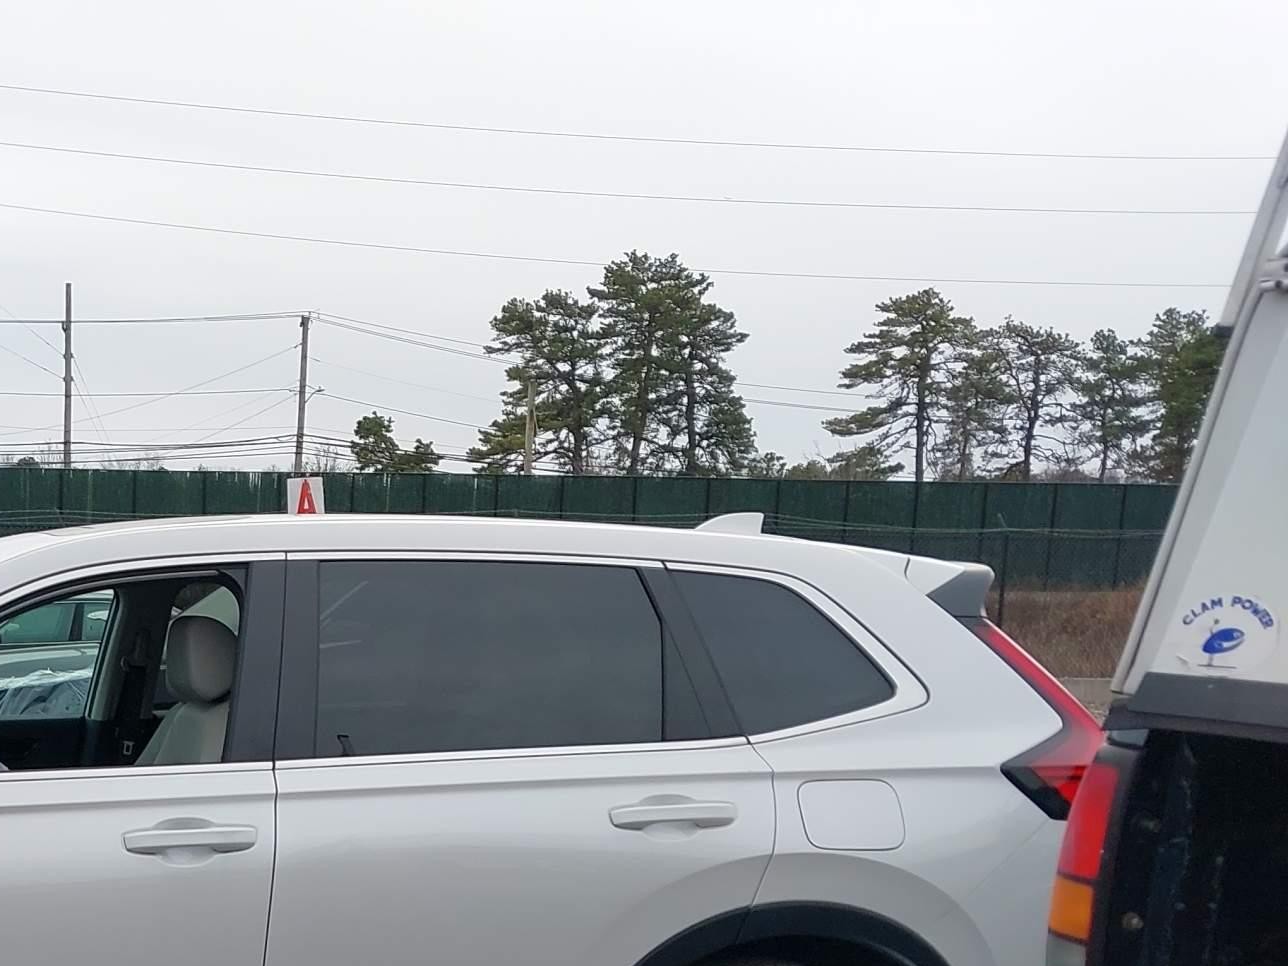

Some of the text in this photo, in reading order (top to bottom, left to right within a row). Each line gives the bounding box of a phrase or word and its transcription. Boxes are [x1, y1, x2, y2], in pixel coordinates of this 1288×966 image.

[297, 479, 317, 514] A
[1182, 596, 1274, 629] CLAM POWER
